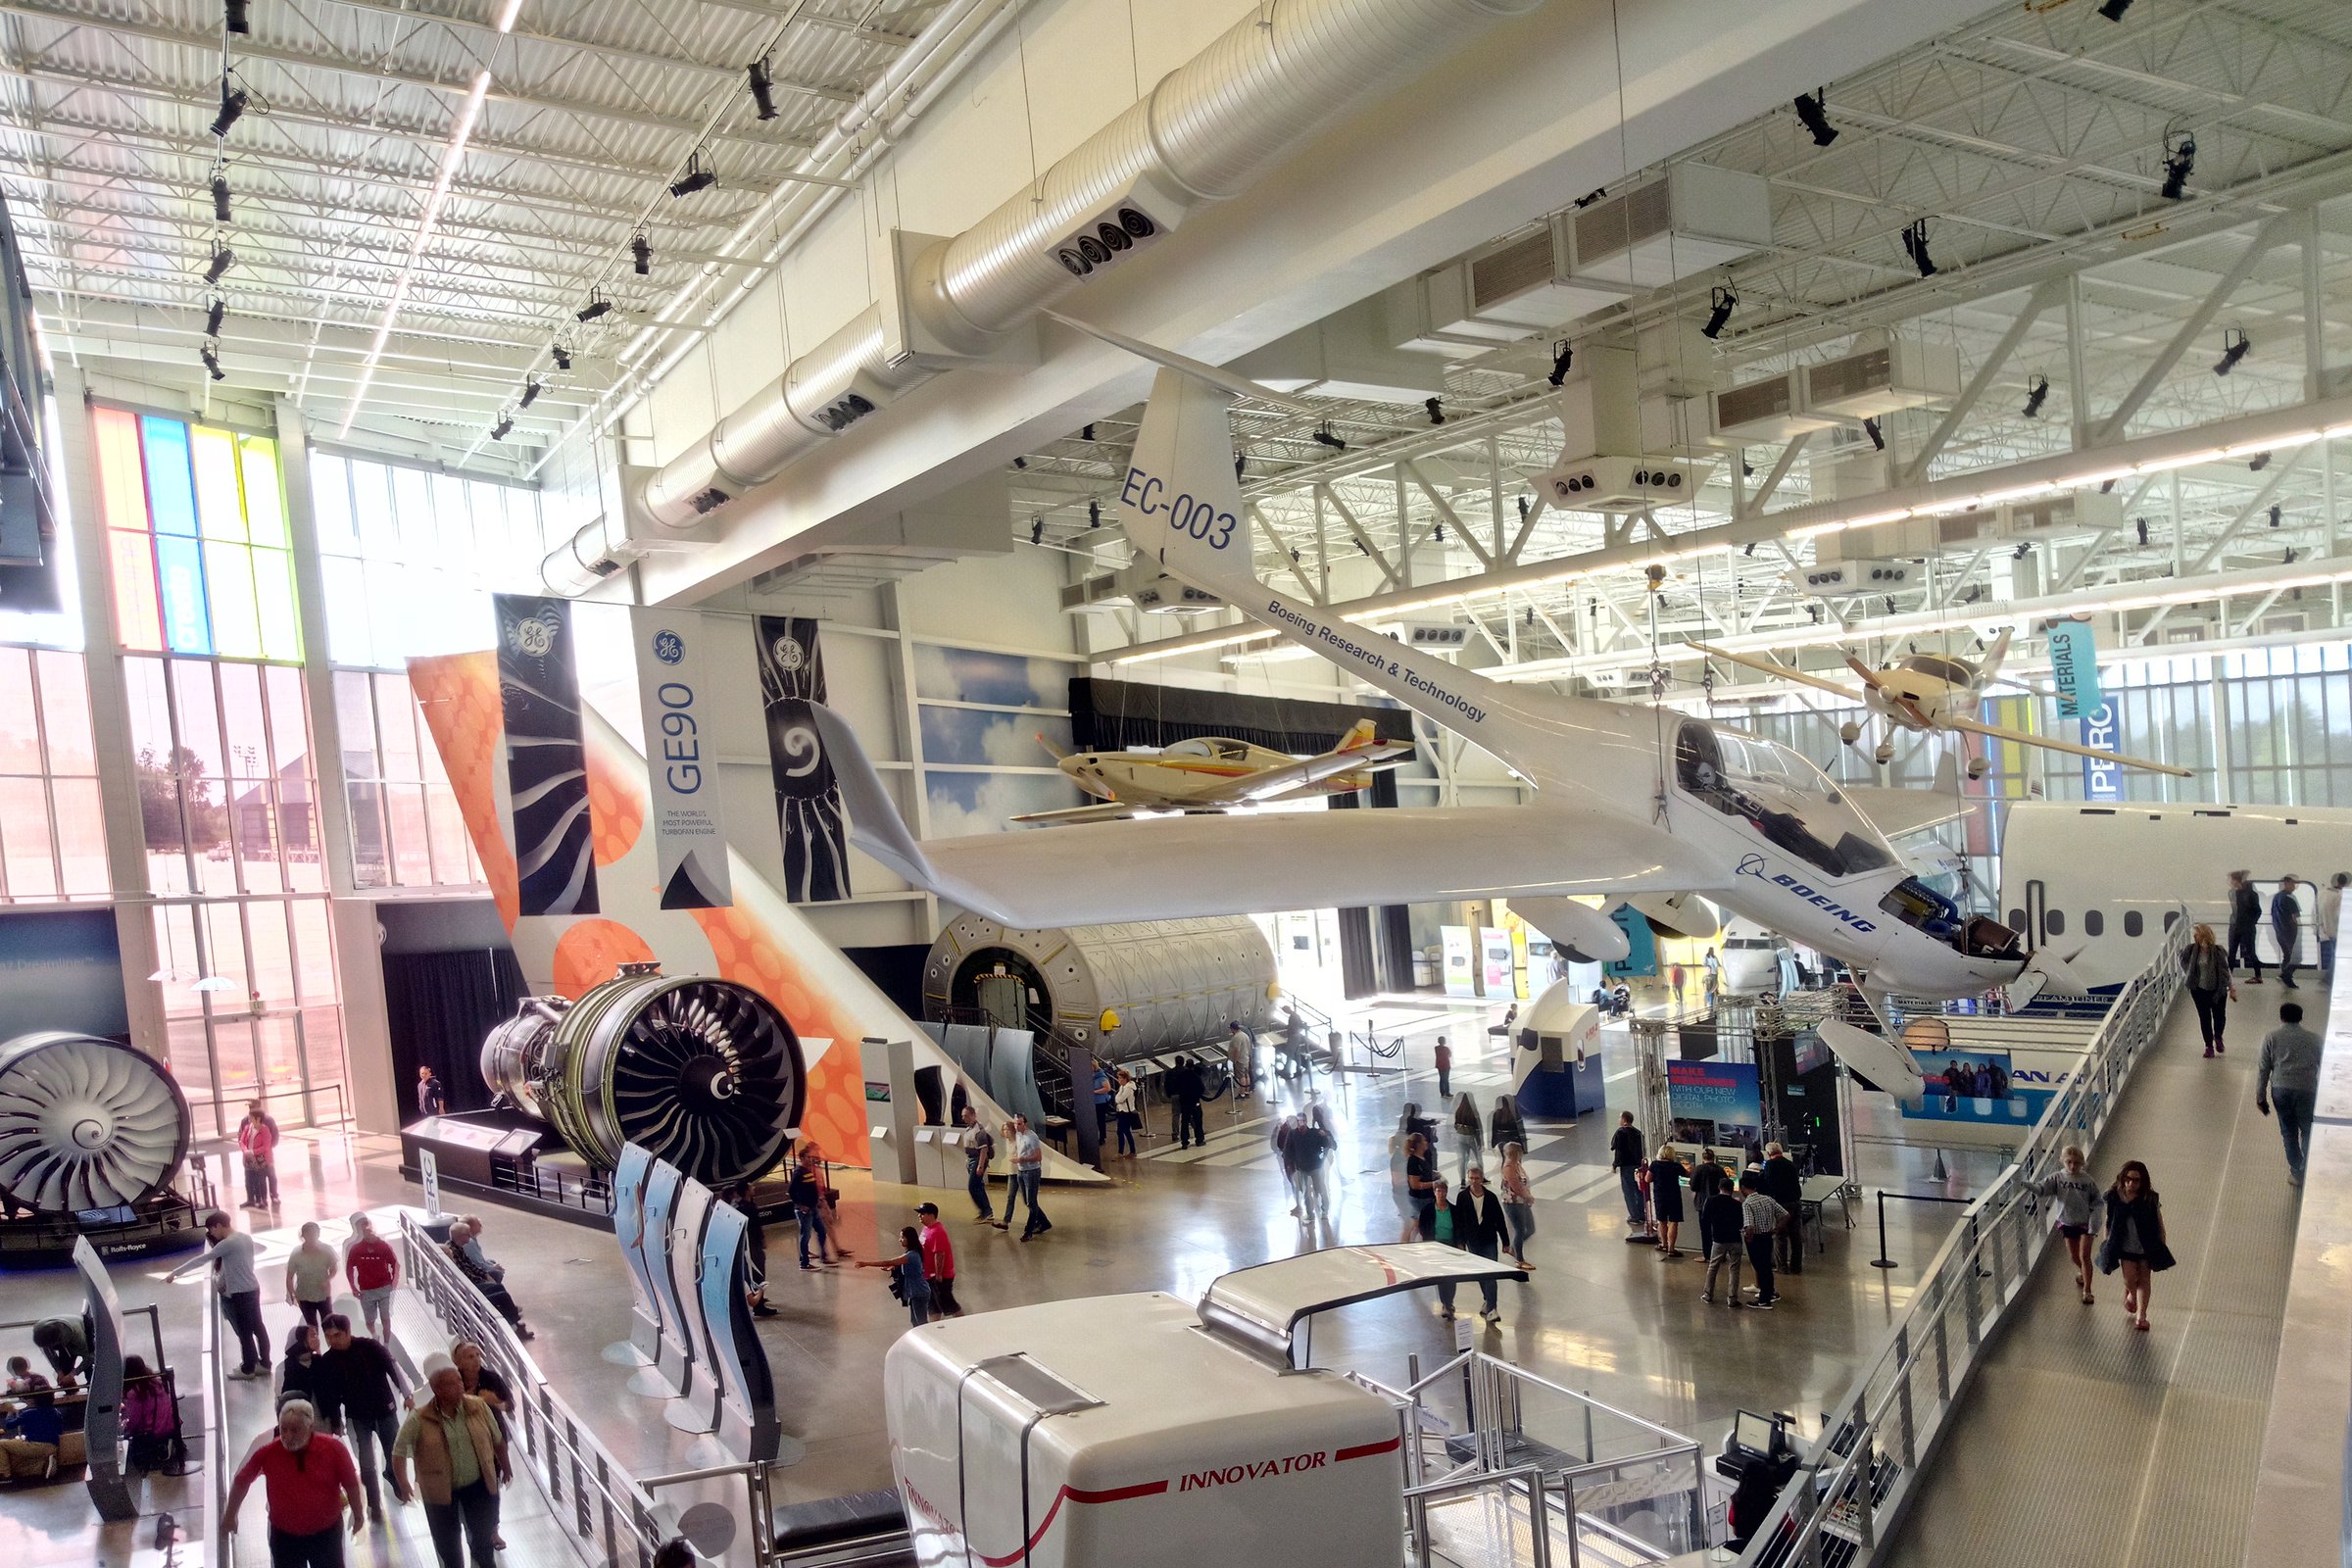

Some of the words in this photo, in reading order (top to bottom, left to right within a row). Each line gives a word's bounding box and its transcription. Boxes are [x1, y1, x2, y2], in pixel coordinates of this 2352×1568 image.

[1120, 466, 1237, 550] EC-003
[1267, 600, 1317, 636] Boeing
[1318, 625, 1390, 671] Research
[1388, 662, 1398, 678] &
[1403, 668, 1488, 724] Technology
[658, 683, 702, 795] GE90
[1771, 873, 1877, 932] BOEING
[2012, 1069, 2051, 1083] AN
[1694, 1086, 1715, 1095] OUR
[1715, 1087, 1737, 1096] NEW
[1671, 1093, 1703, 1102] DIGITAL
[1704, 1095, 1736, 1104] PHOTO
[1671, 1101, 1703, 1109] BOOTH
[2059, 1181, 2088, 1192] YALE
[111, 1244, 147, 1252] Rolls-Royce
[1179, 1451, 1326, 1492] INNOVATOR
